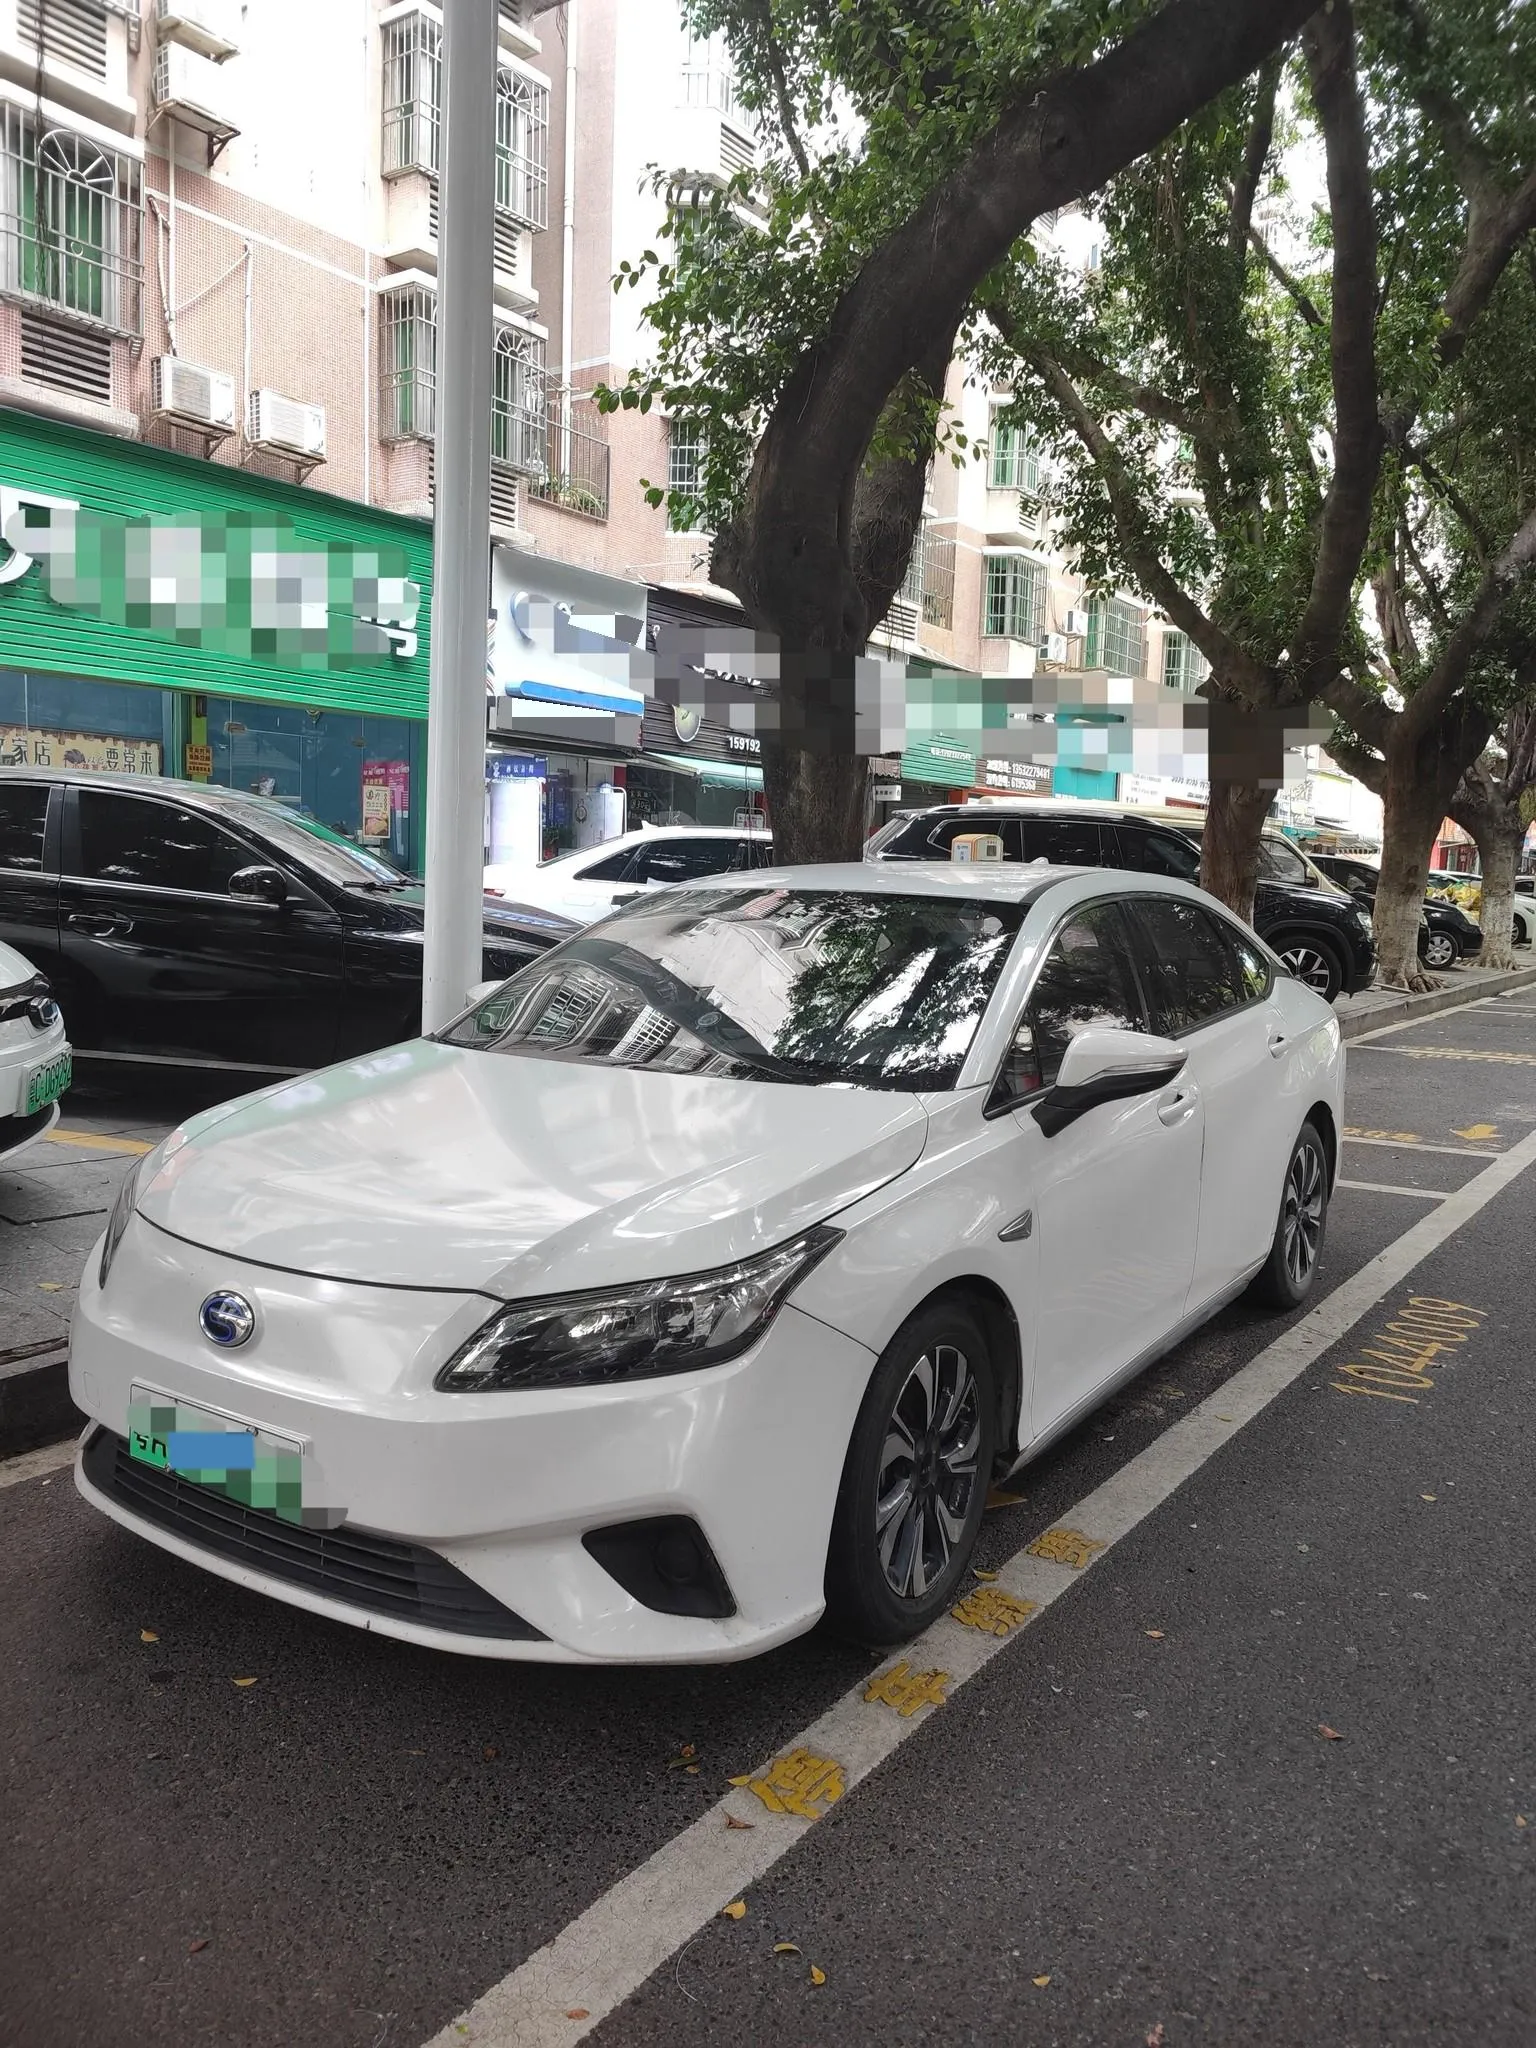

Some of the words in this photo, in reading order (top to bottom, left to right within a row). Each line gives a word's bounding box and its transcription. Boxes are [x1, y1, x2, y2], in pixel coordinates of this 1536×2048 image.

[0, 736, 51, 766] 家店
[105, 747, 153, 776] 要常来
[728, 735, 761, 753] 159192
[1328, 1296, 1489, 1405] 1044009
